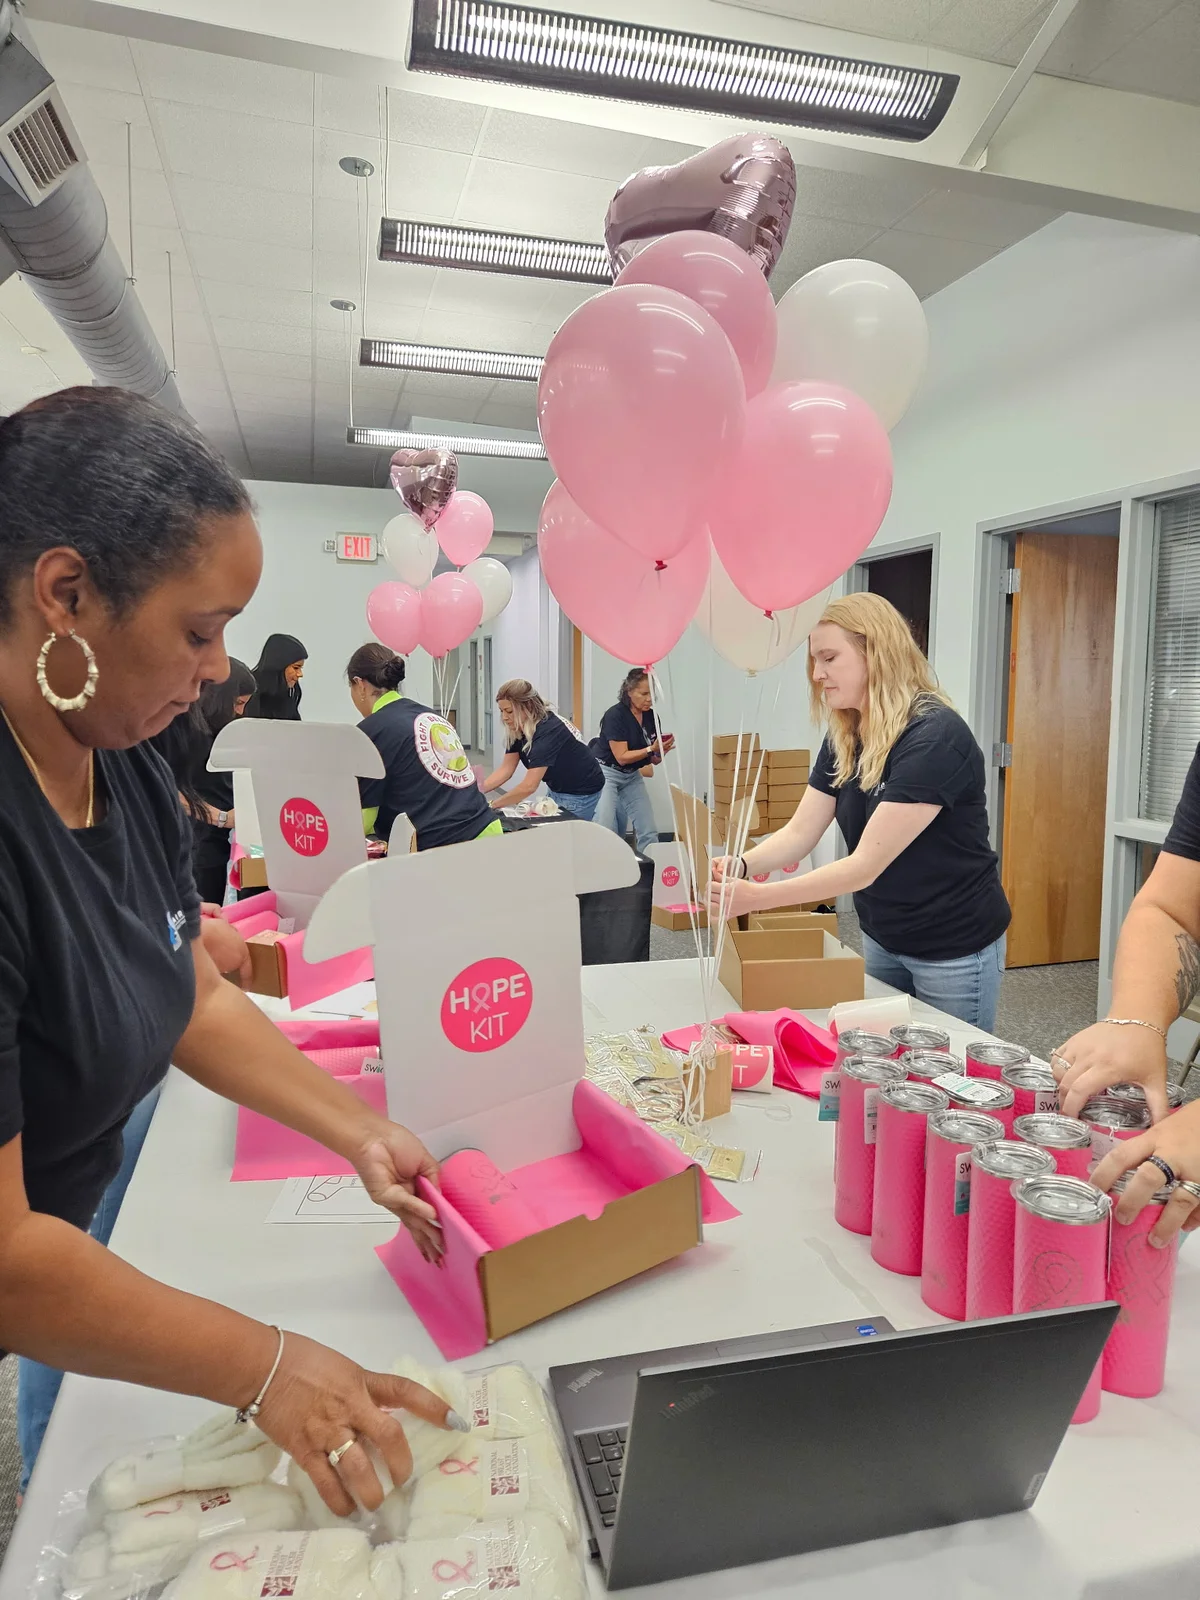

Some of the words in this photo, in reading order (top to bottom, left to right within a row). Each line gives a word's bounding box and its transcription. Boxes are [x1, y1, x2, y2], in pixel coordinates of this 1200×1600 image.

[344, 536, 372, 558] EXIT
[419, 722, 429, 752] FIGHT
[431, 762, 469, 784] SURVIVE
[284, 808, 325, 832] HOPE
[294, 832, 315, 850] KIT
[450, 973, 526, 1014] HOPE
[470, 1011, 509, 1044] KIT
